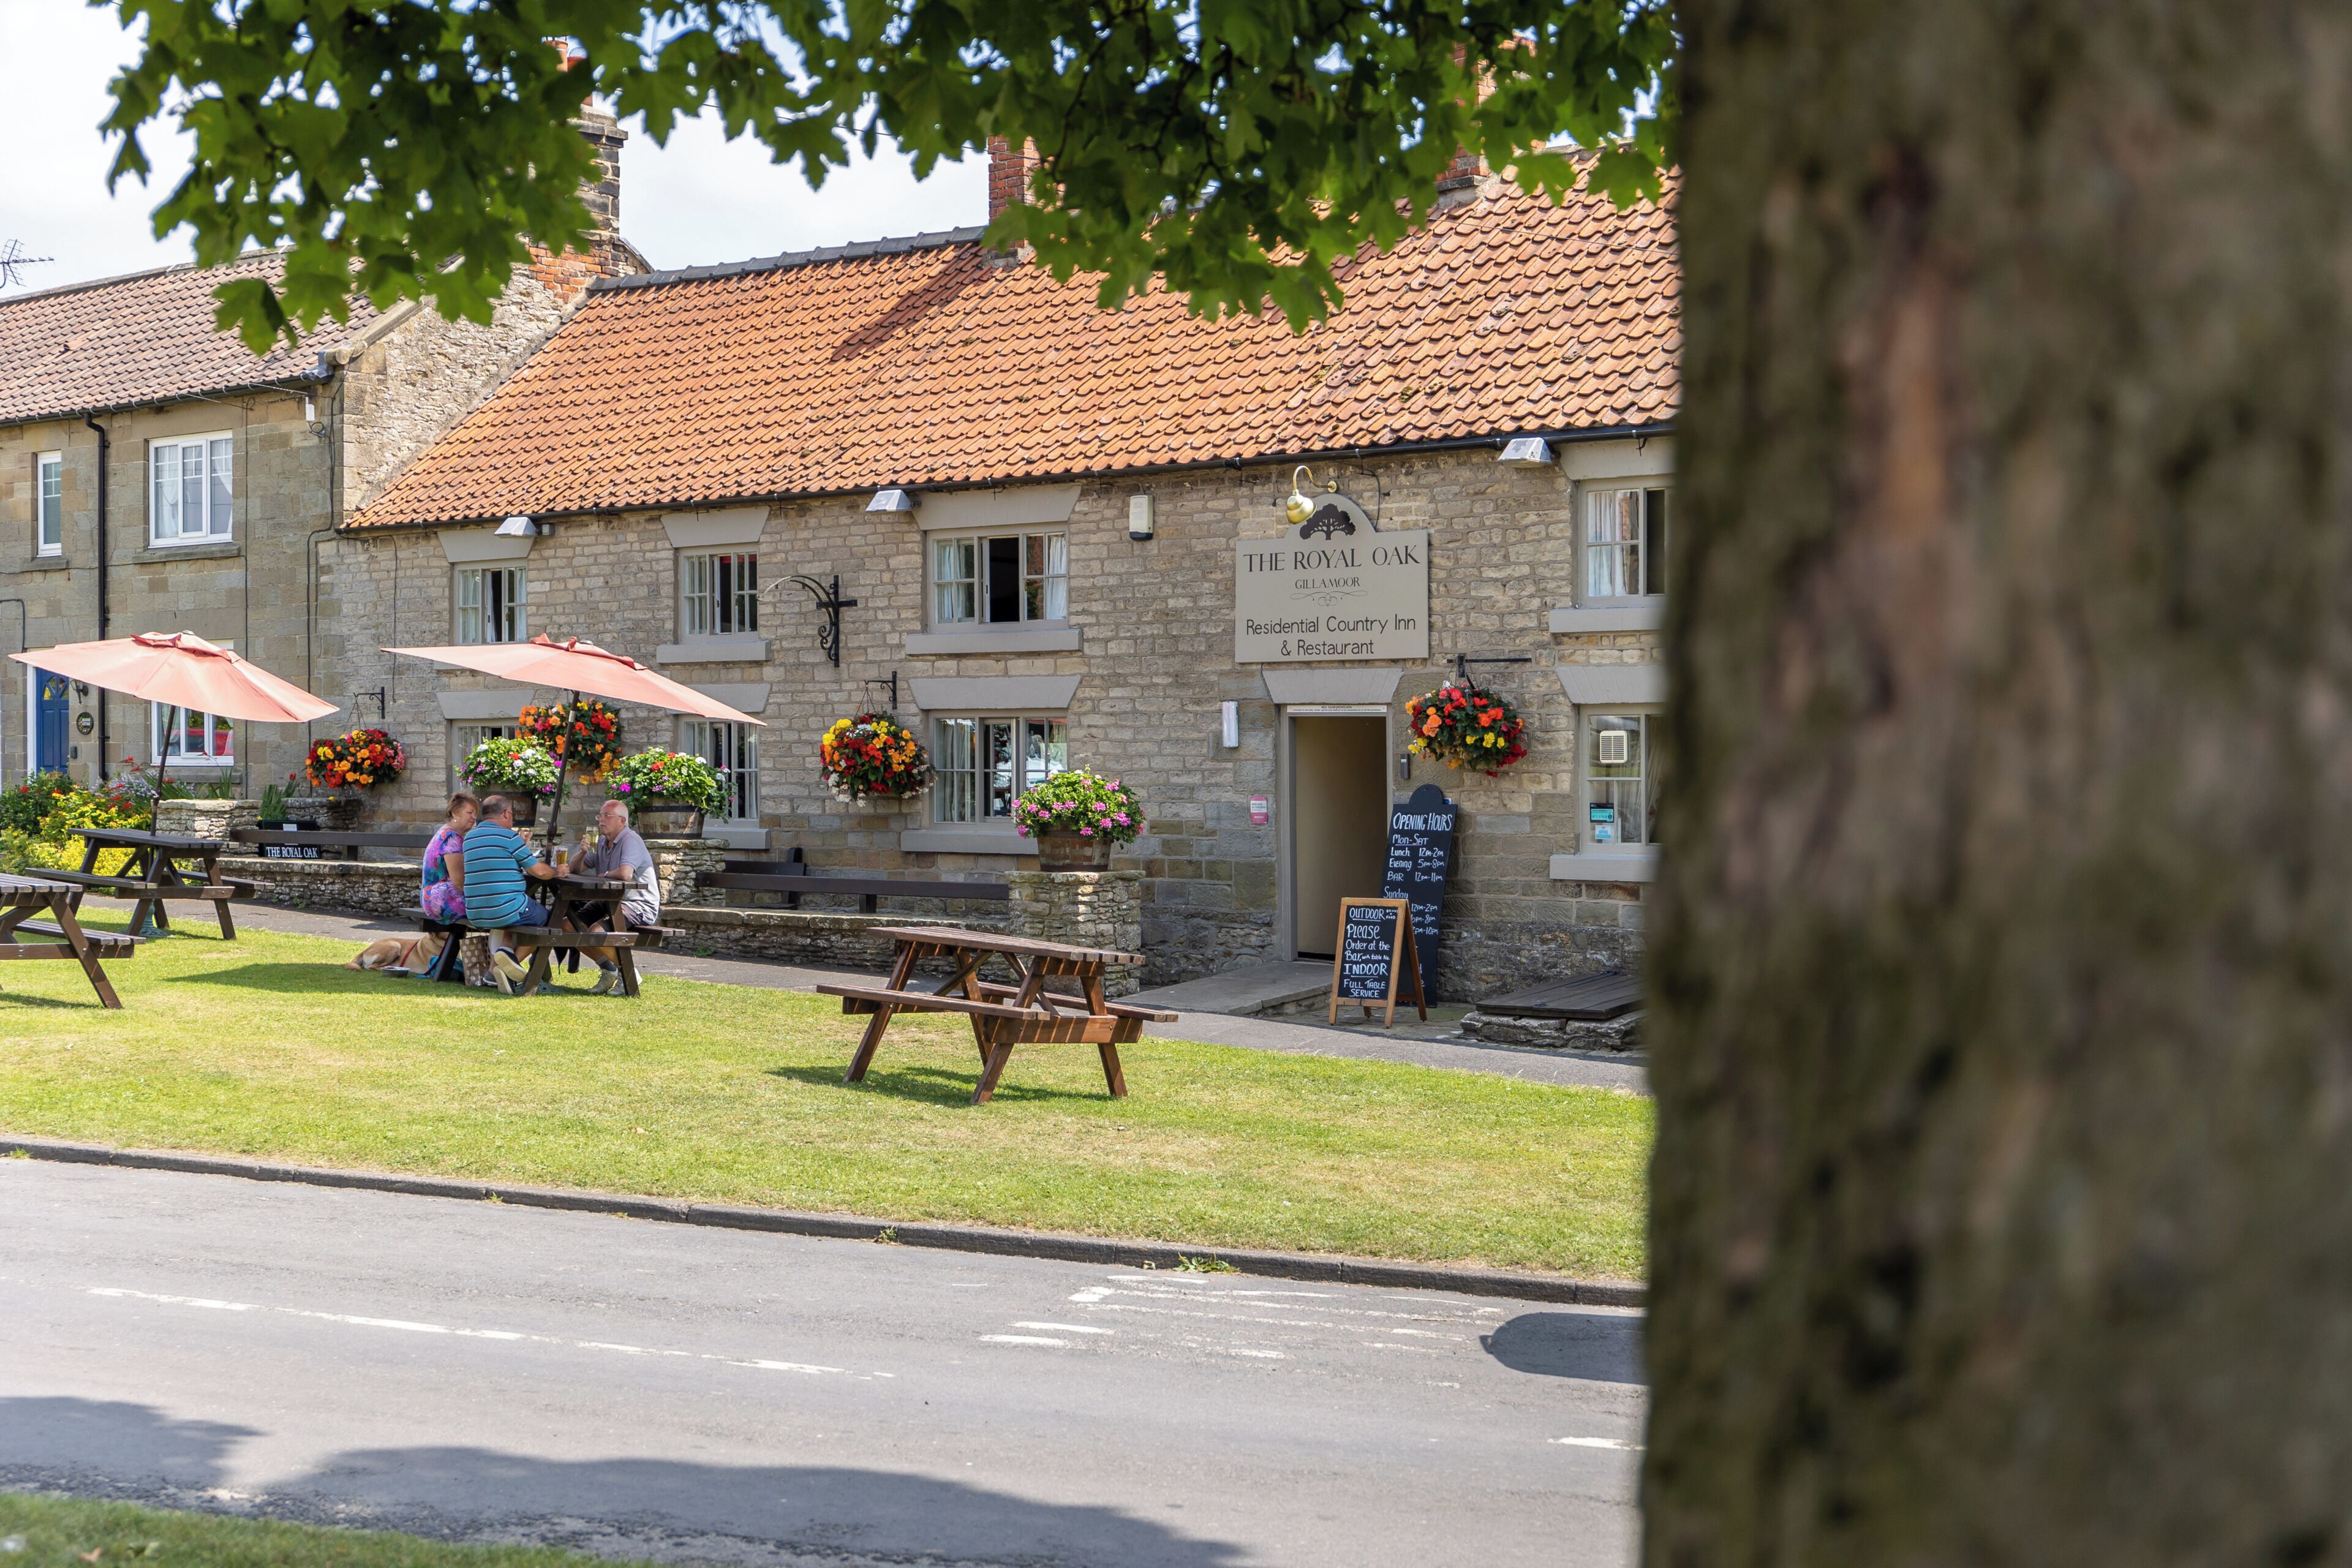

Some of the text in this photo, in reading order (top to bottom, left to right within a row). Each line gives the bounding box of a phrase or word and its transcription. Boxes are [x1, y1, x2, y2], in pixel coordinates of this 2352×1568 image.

[1243, 545, 1420, 572] THE ROYAL OAK
[1295, 576, 1360, 589] GILLAMOOR
[1246, 614, 1415, 635] Residential Country Inn
[1281, 639, 1374, 656] & Restaurant
[1393, 812, 1453, 831] OPENING HOURS
[266, 846, 318, 858] THE ROYAL OAK
[1391, 846, 1411, 857] Lunch
[1387, 870, 1404, 881] BAR
[1383, 886, 1408, 899] Sunday
[1349, 907, 1385, 920] OUTDOOR
[1346, 939, 1390, 951] Order at the
[1343, 963, 1388, 976] INDOOR
[1344, 979, 1385, 989] FULL TABLE
[1349, 989, 1380, 998] SERVICE
